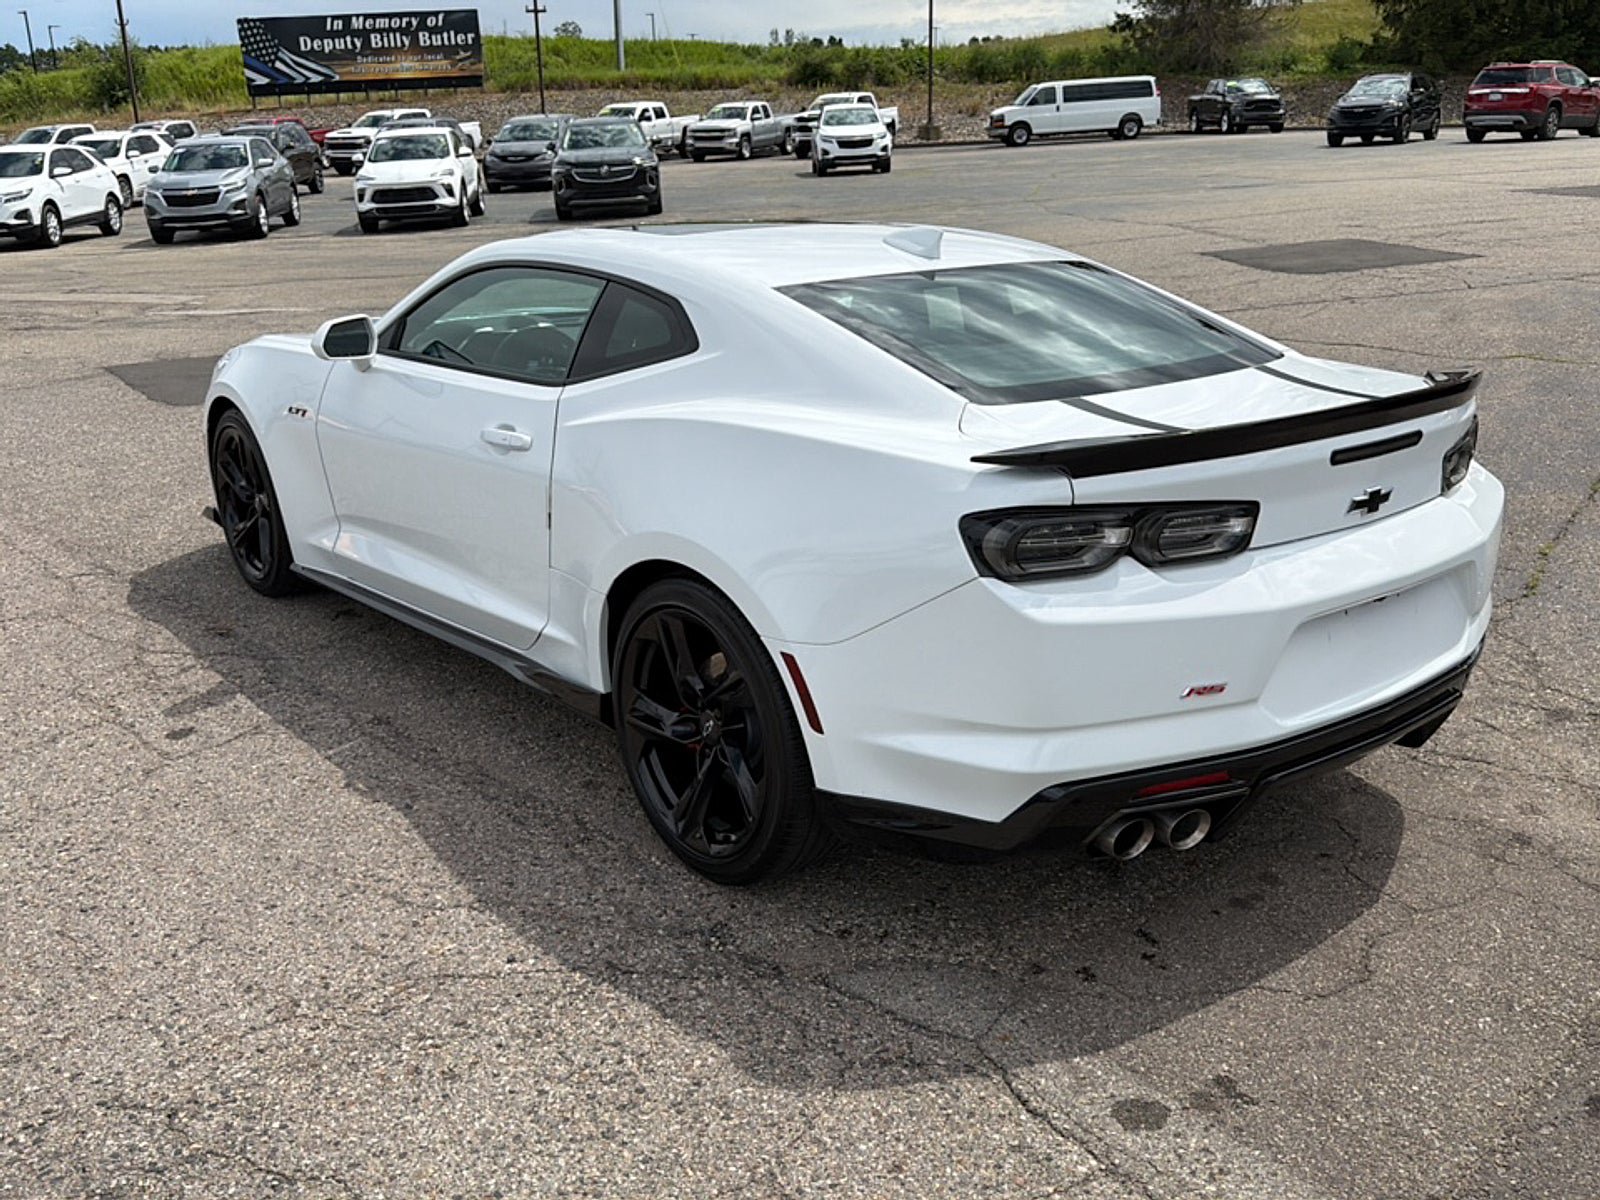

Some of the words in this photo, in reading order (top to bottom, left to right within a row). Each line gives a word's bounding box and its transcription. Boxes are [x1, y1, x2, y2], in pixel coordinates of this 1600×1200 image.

[326, 17, 343, 31] In
[351, 15, 420, 31] Memory
[426, 13, 445, 27] of
[299, 34, 363, 53] Deputy
[370, 32, 411, 49] Billy
[418, 30, 475, 46] Butler
[1179, 683, 1227, 700] RS
